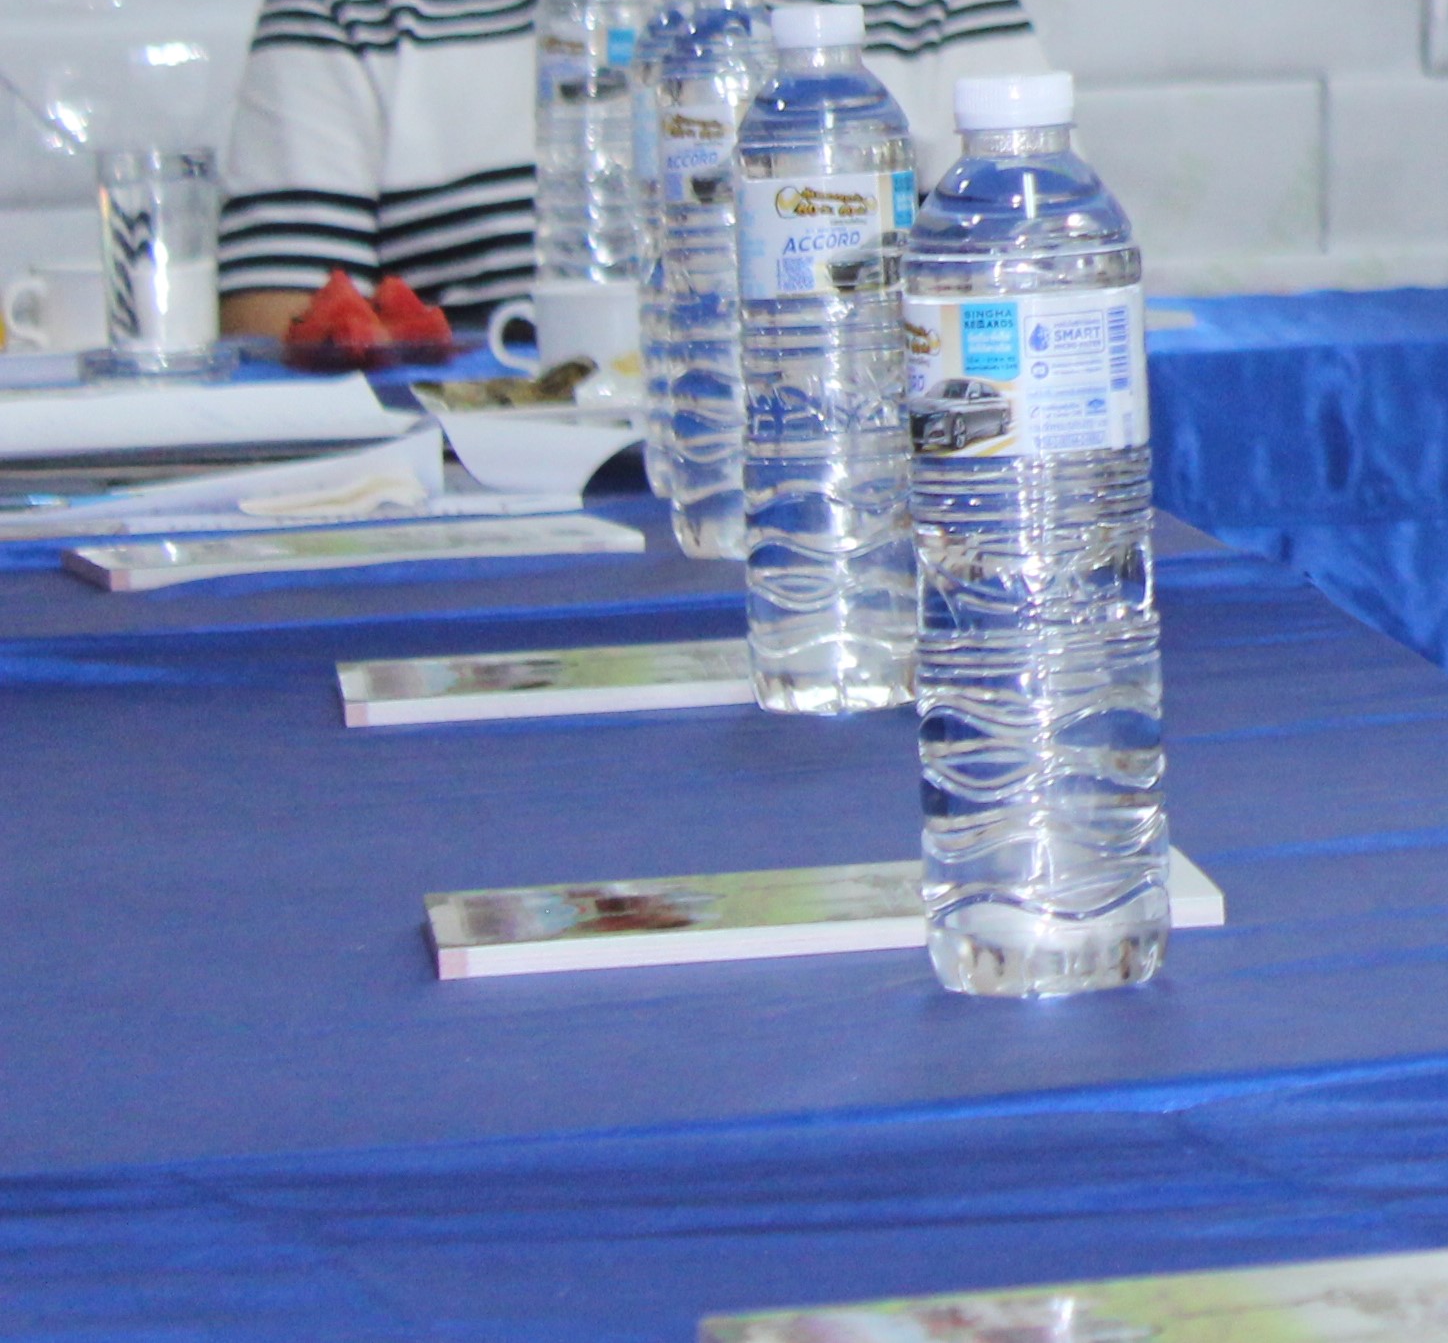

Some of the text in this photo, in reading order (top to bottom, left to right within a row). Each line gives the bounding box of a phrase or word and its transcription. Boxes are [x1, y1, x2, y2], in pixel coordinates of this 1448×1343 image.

[783, 231, 861, 255] ACCORD
[964, 309, 1012, 319] SINGHA
[1054, 326, 1101, 342] SMART
